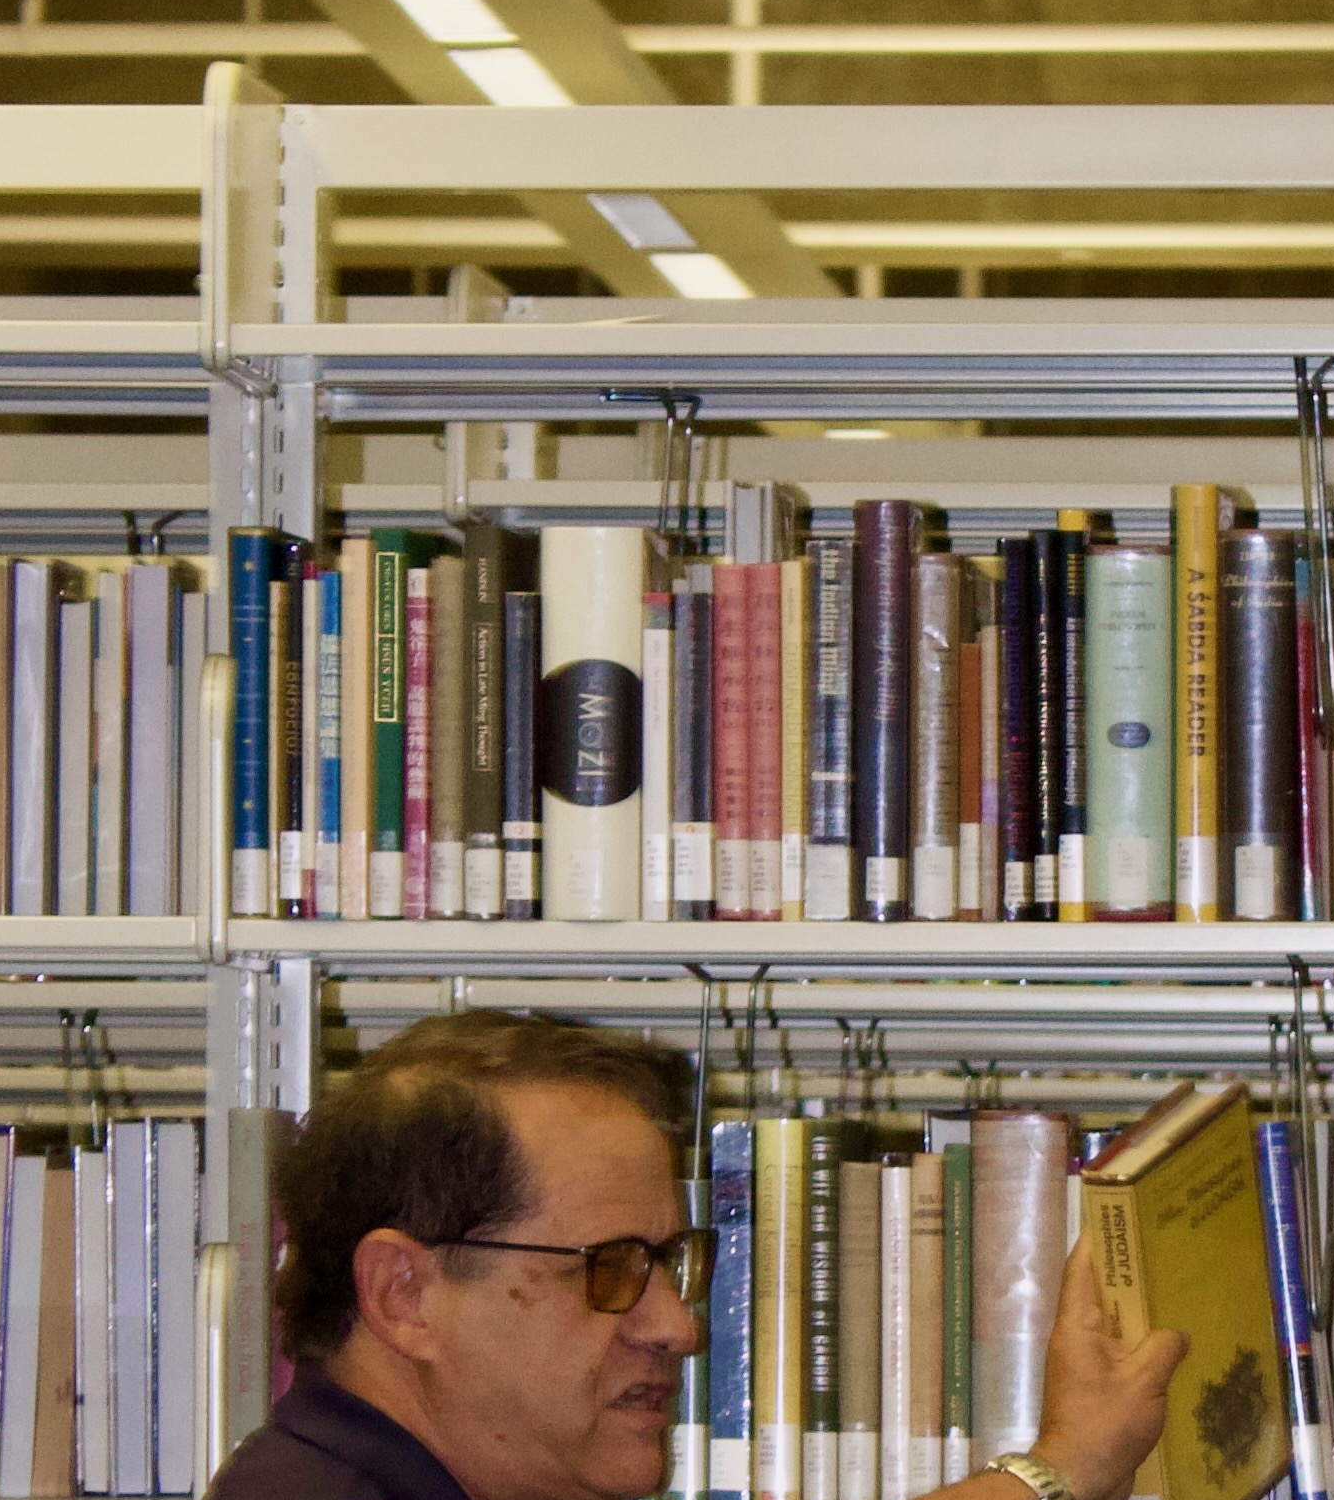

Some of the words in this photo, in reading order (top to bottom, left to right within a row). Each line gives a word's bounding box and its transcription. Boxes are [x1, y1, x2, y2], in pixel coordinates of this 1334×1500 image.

[1187, 568, 1206, 584] A
[477, 628, 490, 658] Action
[1187, 591, 1212, 665] ŚABDA
[477, 672, 490, 693] Late
[478, 661, 490, 670] in
[286, 660, 301, 758] CONFUCIUS
[475, 696, 489, 721] Ming
[1187, 675, 1206, 758] READER
[476, 724, 489, 766] Thought
[1099, 1205, 1116, 1288] Philosophies
[1114, 1205, 1131, 1271] JUDAISM
[1123, 1275, 1133, 1288] of
